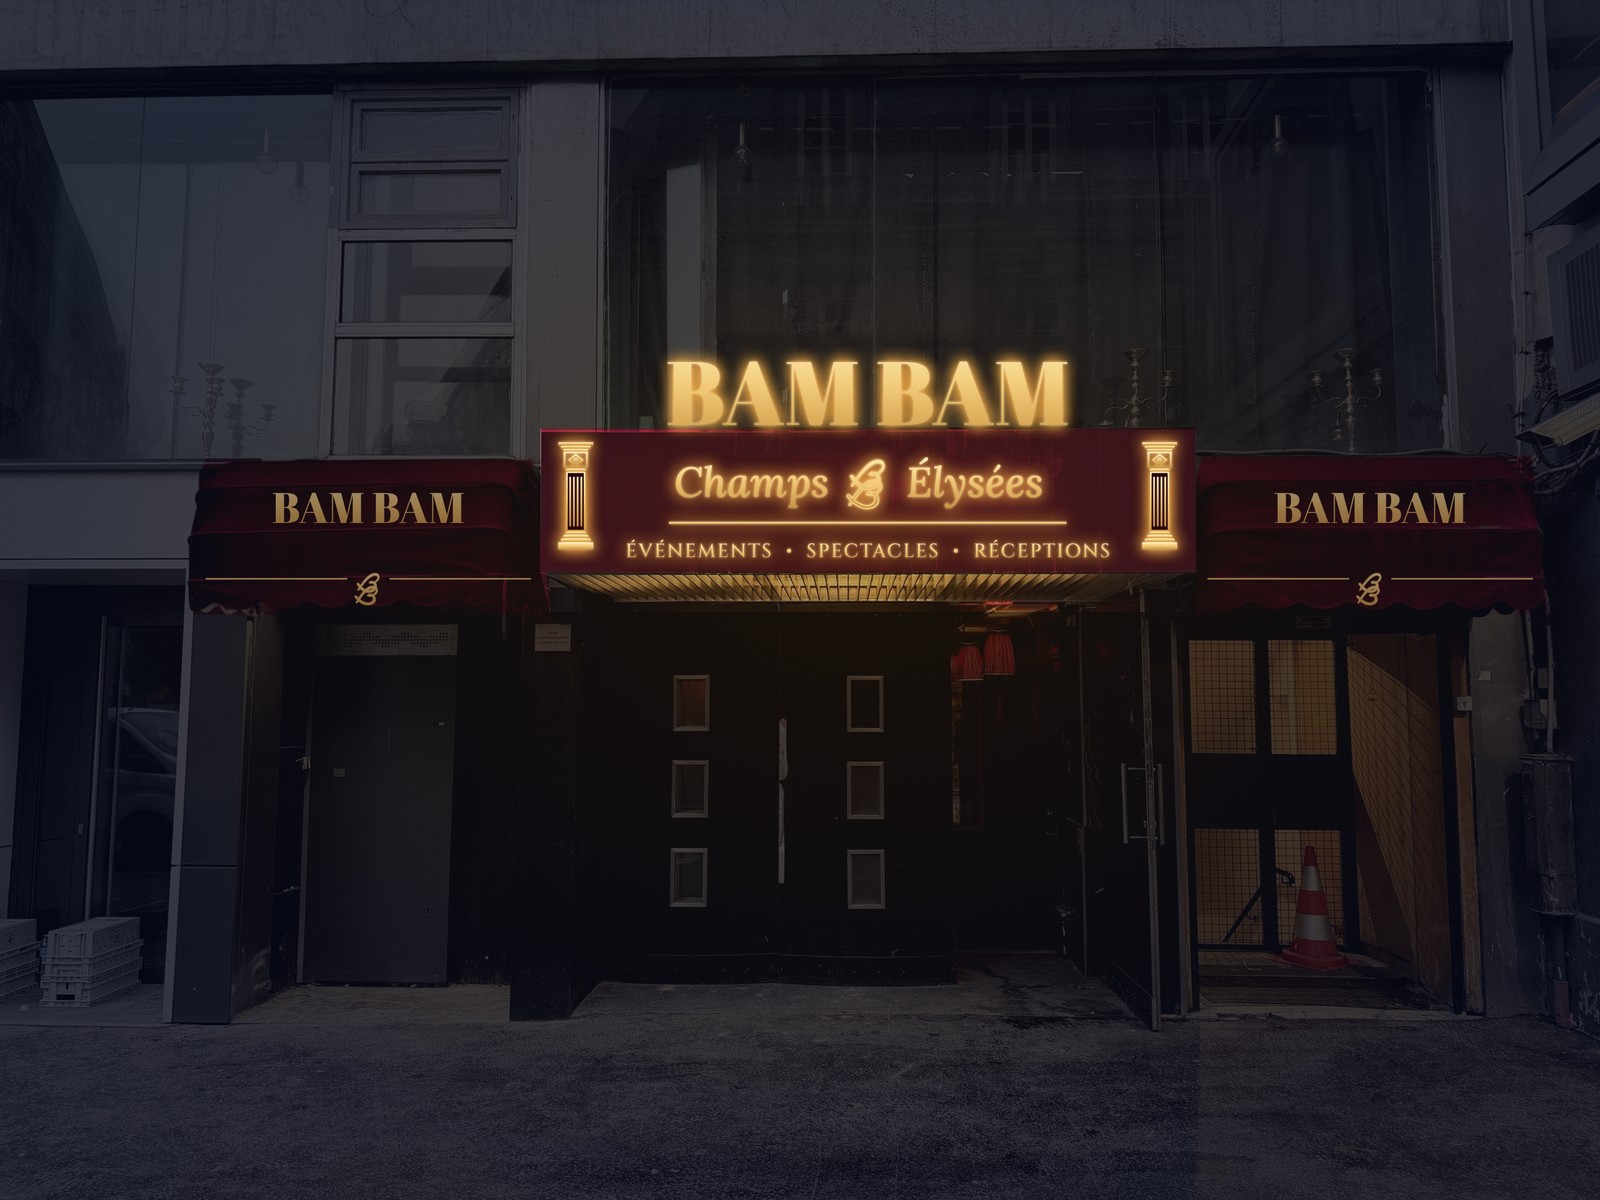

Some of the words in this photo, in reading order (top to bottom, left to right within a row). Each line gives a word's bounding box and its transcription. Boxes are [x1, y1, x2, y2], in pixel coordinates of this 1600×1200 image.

[668, 361, 858, 426] BAM
[878, 361, 1067, 426] BAM
[676, 465, 827, 508] Champs
[908, 457, 1042, 508] Élysées
[274, 493, 363, 523] BAM
[374, 493, 463, 523] BAM
[1275, 493, 1365, 523] BAM
[1375, 493, 1465, 523] BAM
[626, 540, 772, 558] ÉVÉNEMENTS
[806, 543, 938, 558] SPECTACLES
[975, 540, 1110, 558] RÉCEPTIONS
